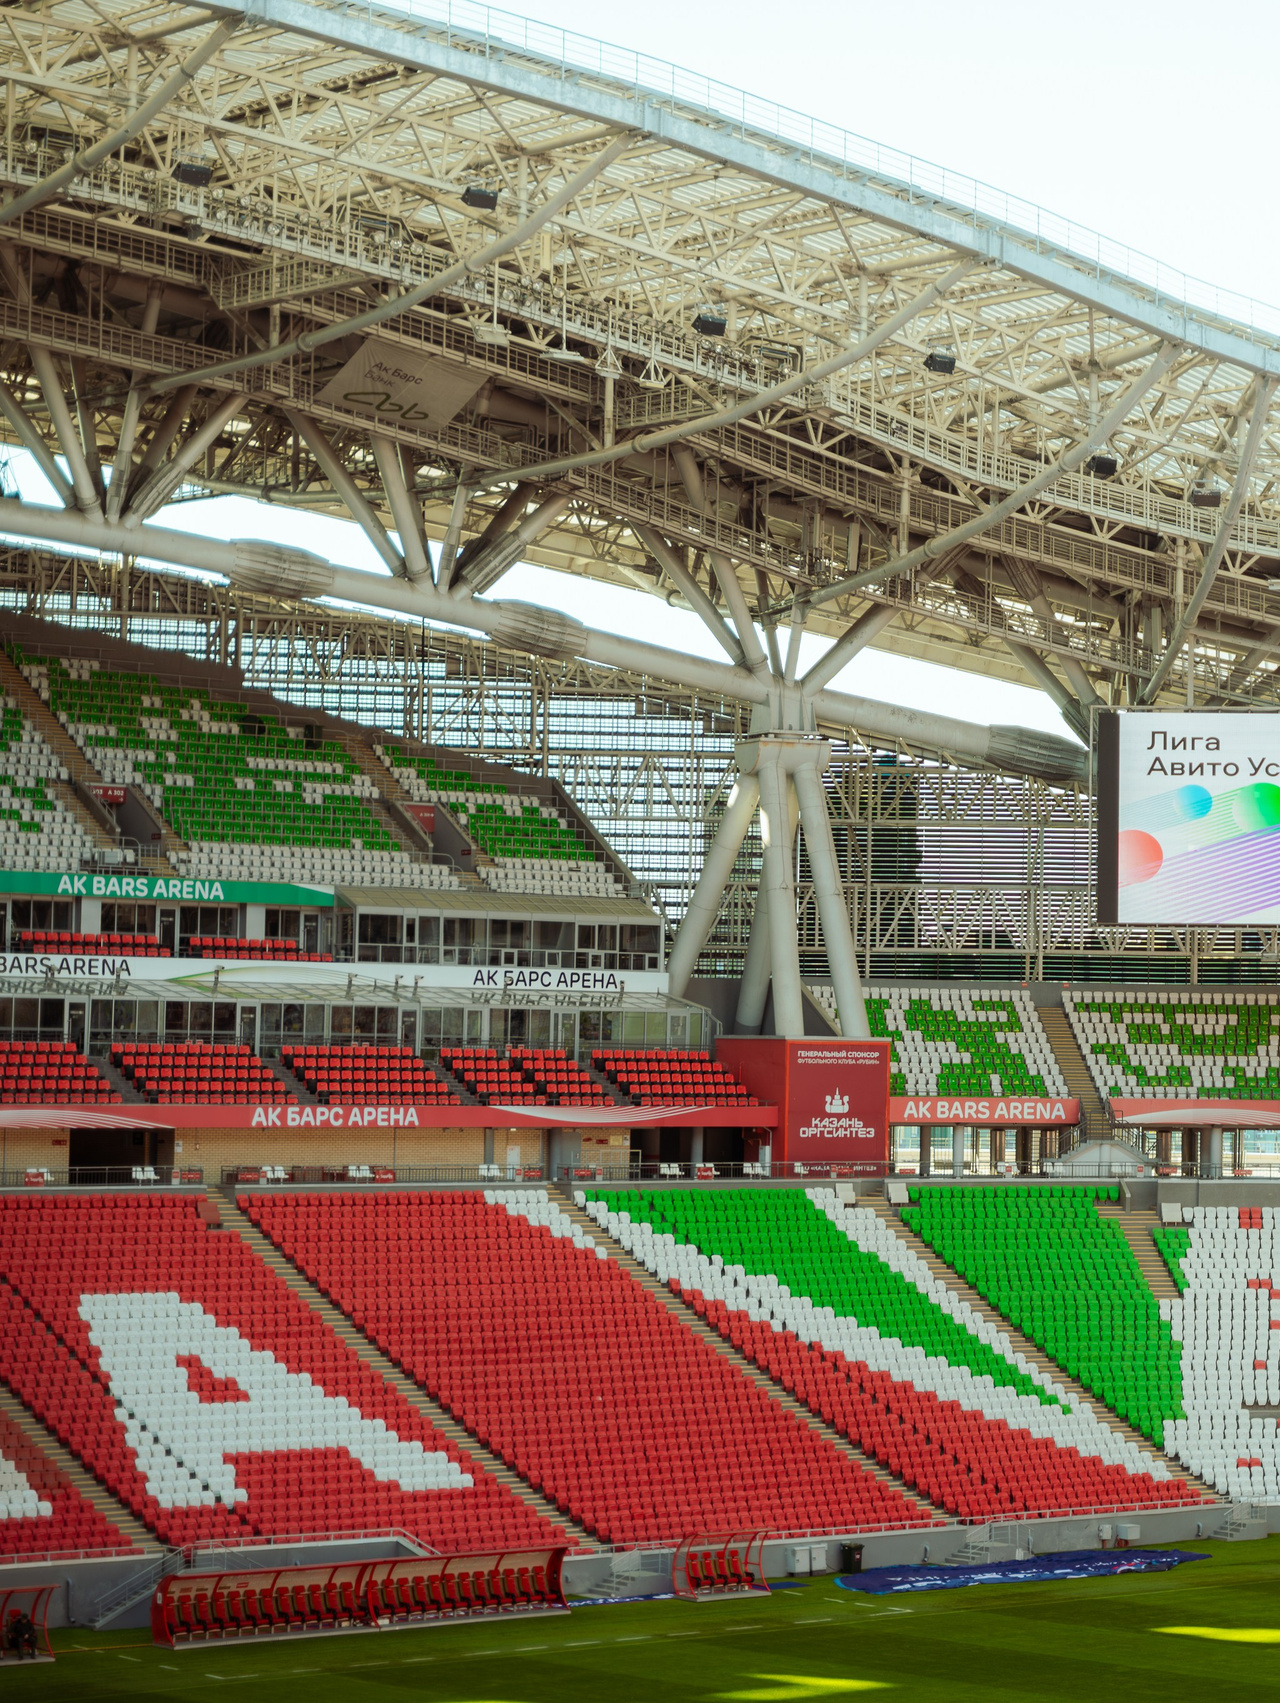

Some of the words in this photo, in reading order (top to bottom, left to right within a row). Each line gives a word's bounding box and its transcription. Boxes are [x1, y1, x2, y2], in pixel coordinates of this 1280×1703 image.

[364, 369, 396, 388] Банк
[372, 361, 391, 374] Ак
[392, 367, 423, 386] Барс
[1147, 731, 1221, 751] Лига
[1147, 756, 1240, 777] Авито
[57, 874, 88, 895] AK
[92, 876, 149, 897] BARS
[153, 878, 225, 901] ARENA
[57, 958, 131, 977] ARENA
[473, 969, 498, 986] АК
[503, 970, 552, 988] БАРС
[556, 972, 618, 989] АРЕНА
[797, 1050, 847, 1058] ГЕНЕРАЛЬНЫЙ
[251, 1106, 282, 1127] АК
[287, 1107, 344, 1127] БАРС
[348, 1107, 419, 1127] АРЕНА
[904, 1101, 932, 1119] AK
[936, 1101, 990, 1119] BARS
[994, 1102, 1066, 1120] ARENA
[811, 1117, 863, 1128] КАЗАНЬ
[799, 1127, 875, 1138] ОРГСИНТЕЗ
